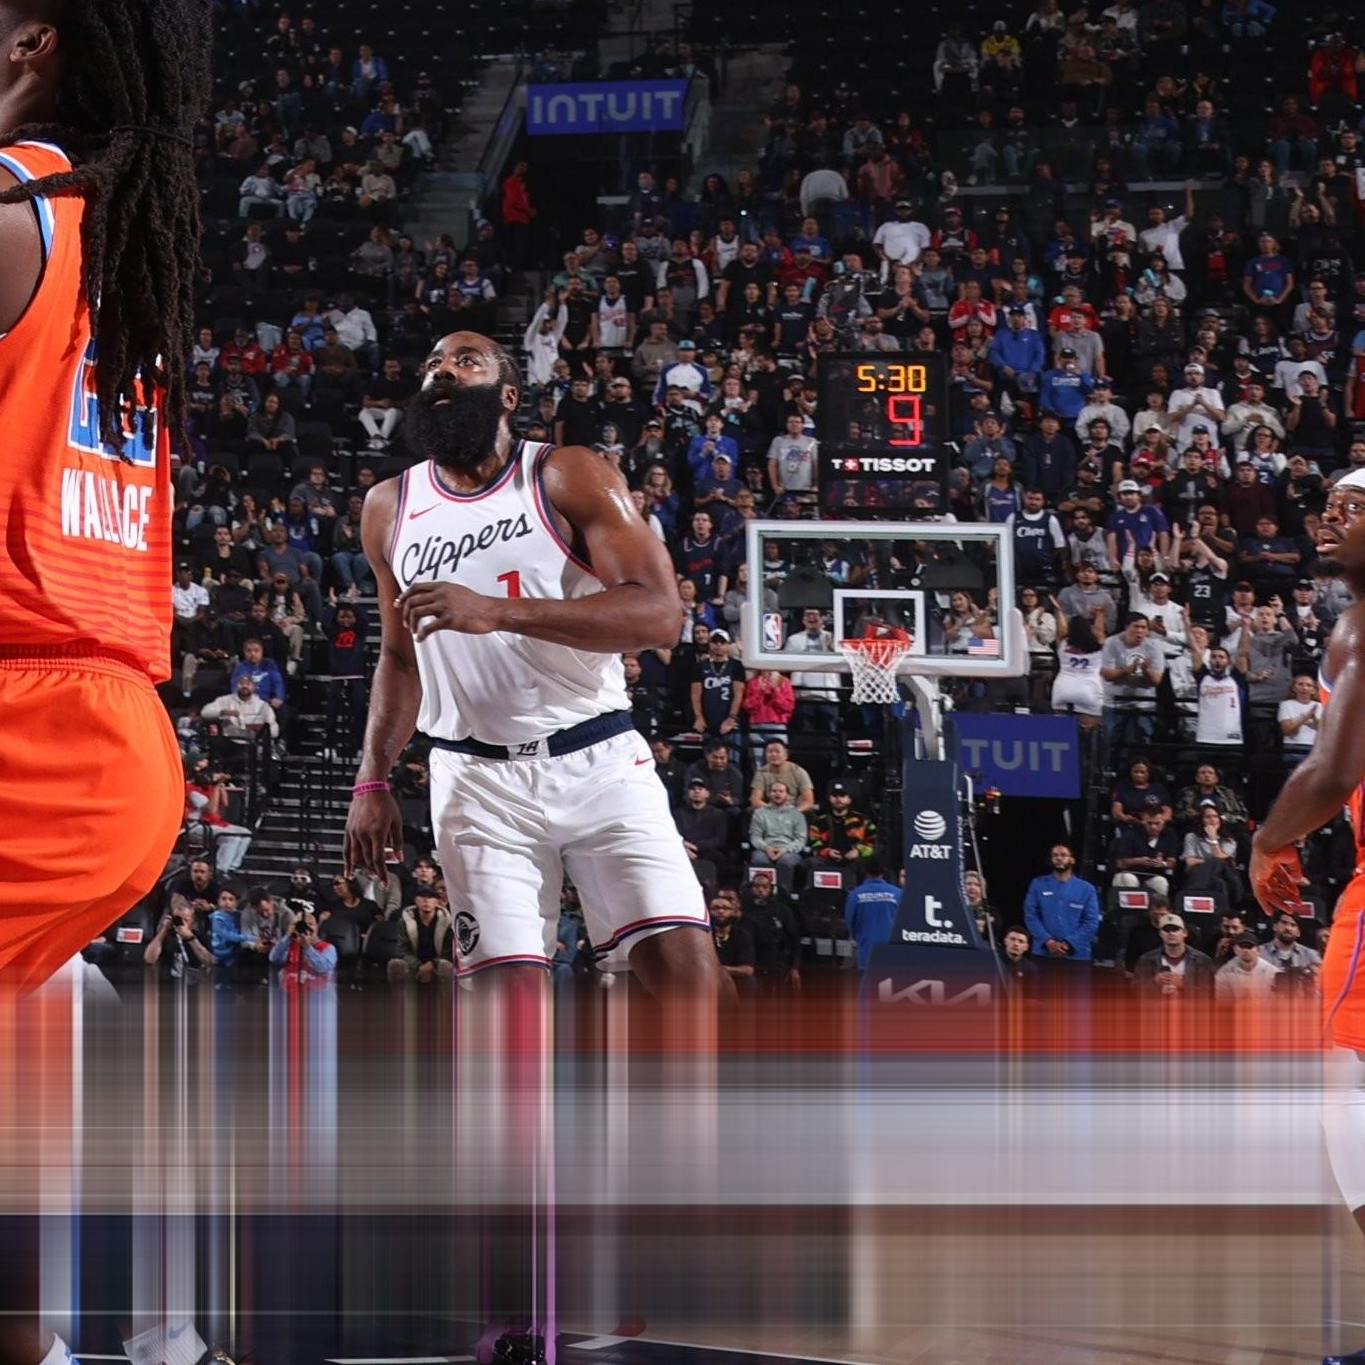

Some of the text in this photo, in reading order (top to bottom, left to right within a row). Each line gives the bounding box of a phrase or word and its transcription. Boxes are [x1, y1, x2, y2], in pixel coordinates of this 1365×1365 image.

[533, 91, 680, 124] INTUIT
[858, 364, 926, 392] 5:30
[888, 395, 920, 446] 9
[859, 457, 935, 473] TISSOT
[401, 512, 533, 586] Clippers
[1193, 584, 1211, 599] 23
[961, 738, 1069, 772] TUIT
[909, 844, 953, 859] AT&T
